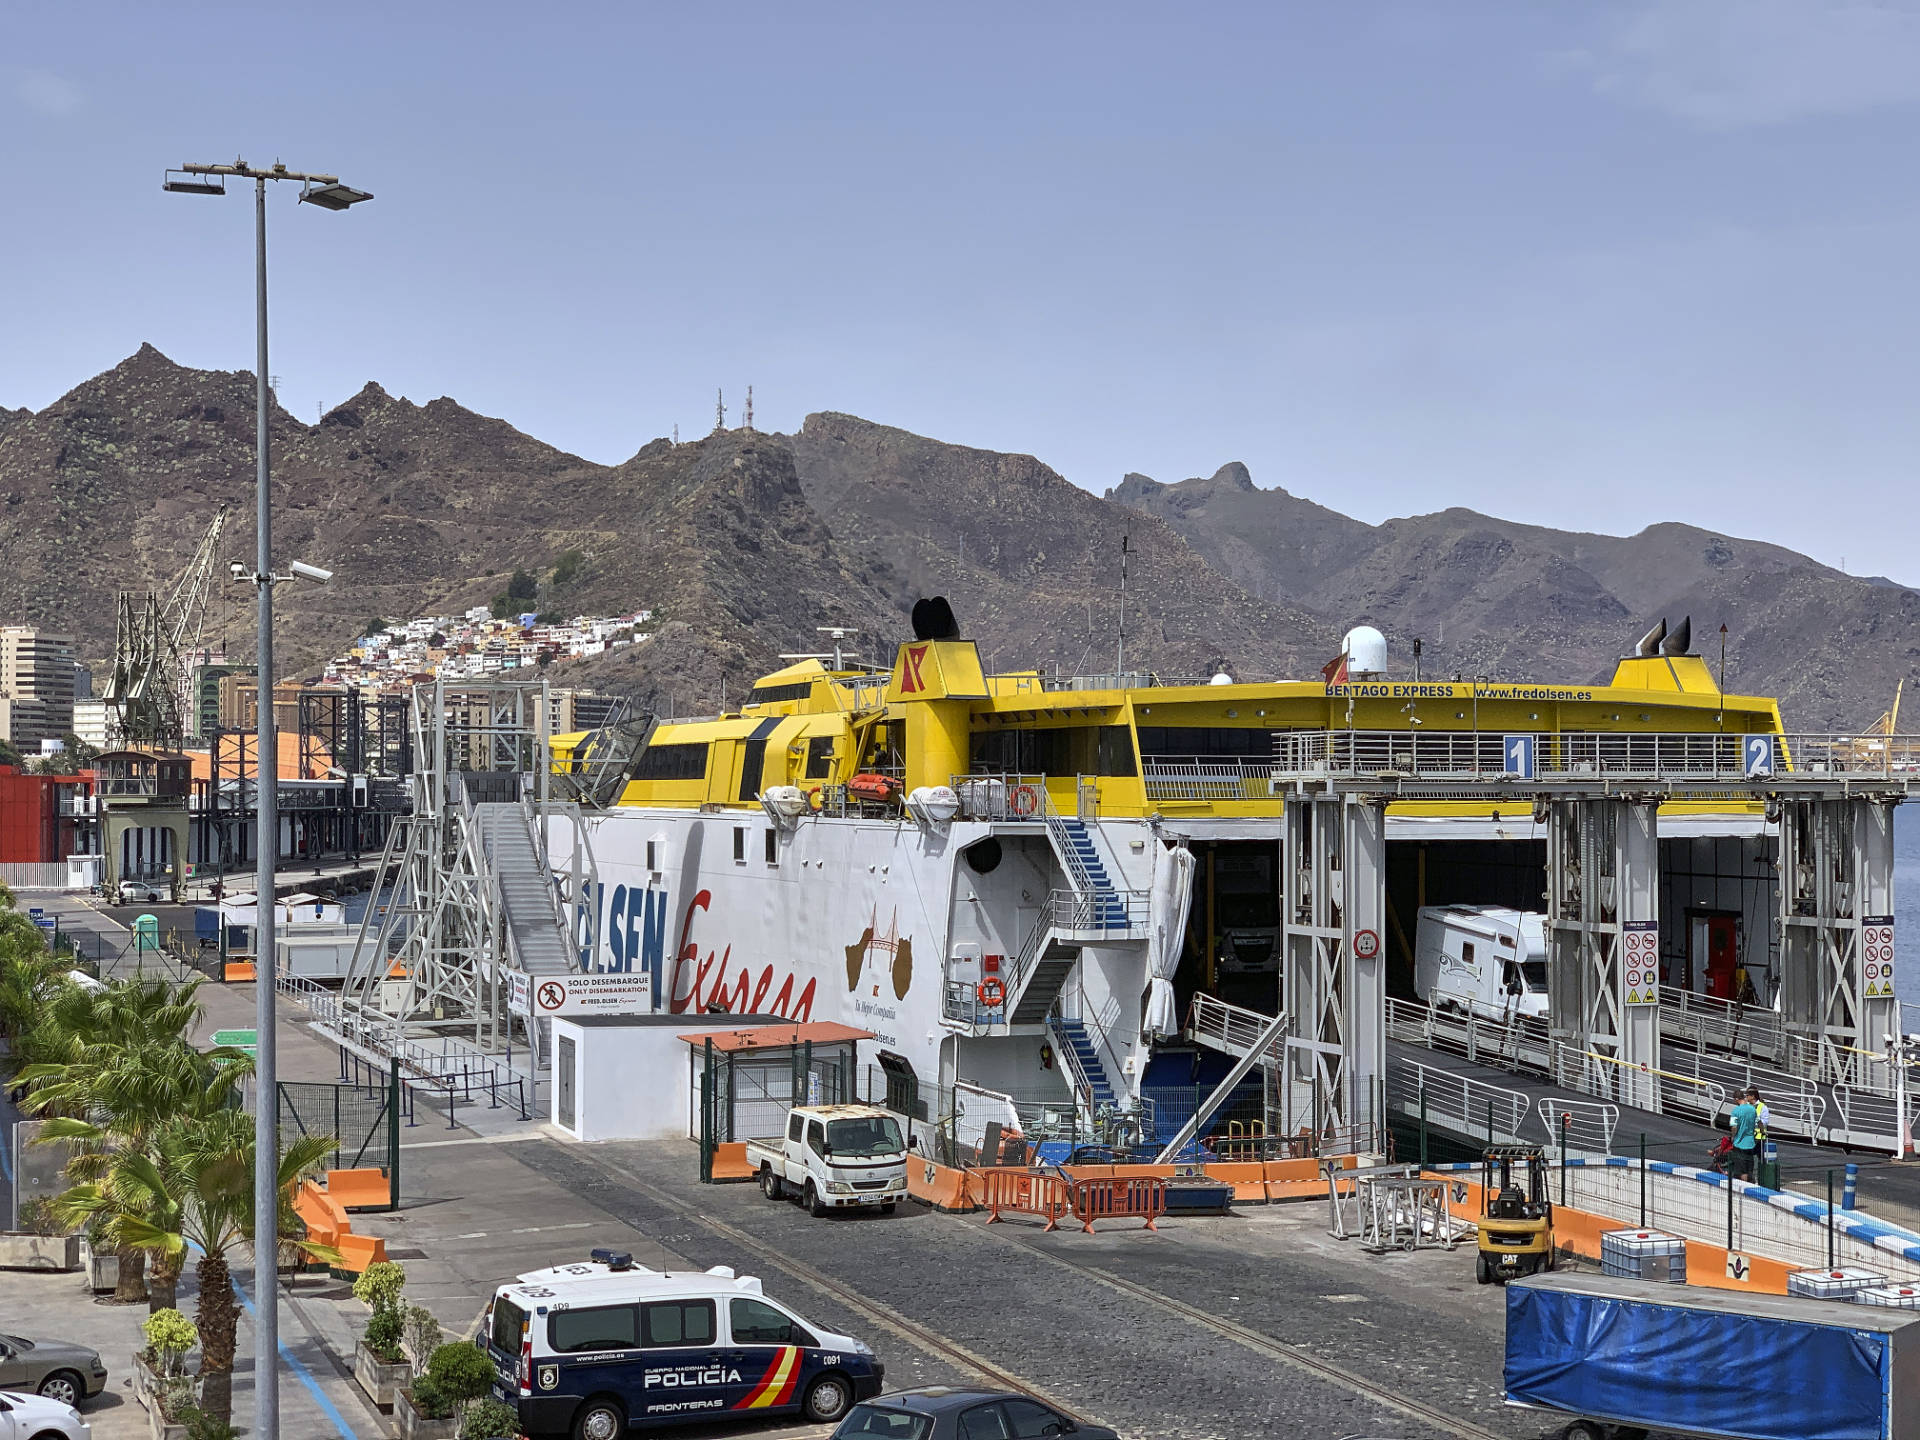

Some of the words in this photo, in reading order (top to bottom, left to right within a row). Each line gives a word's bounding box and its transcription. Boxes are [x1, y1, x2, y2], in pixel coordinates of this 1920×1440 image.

[1325, 685, 1389, 697] BENTAGO
[1393, 685, 1453, 697] EXPRESS
[1476, 687, 1592, 700] www.fredolsen.es
[1511, 740, 1525, 777] 1
[1750, 739, 1768, 777] 2
[568, 979, 590, 987] SOLO
[592, 977, 649, 986] DESEMBARQUE
[589, 986, 648, 994] DISEMBARKATION
[1502, 1254, 1519, 1264] CAT
[576, 1353, 625, 1363] www.policia.es
[644, 1366, 742, 1388] POLICÍA
[647, 1400, 724, 1413] FRONTERAS
